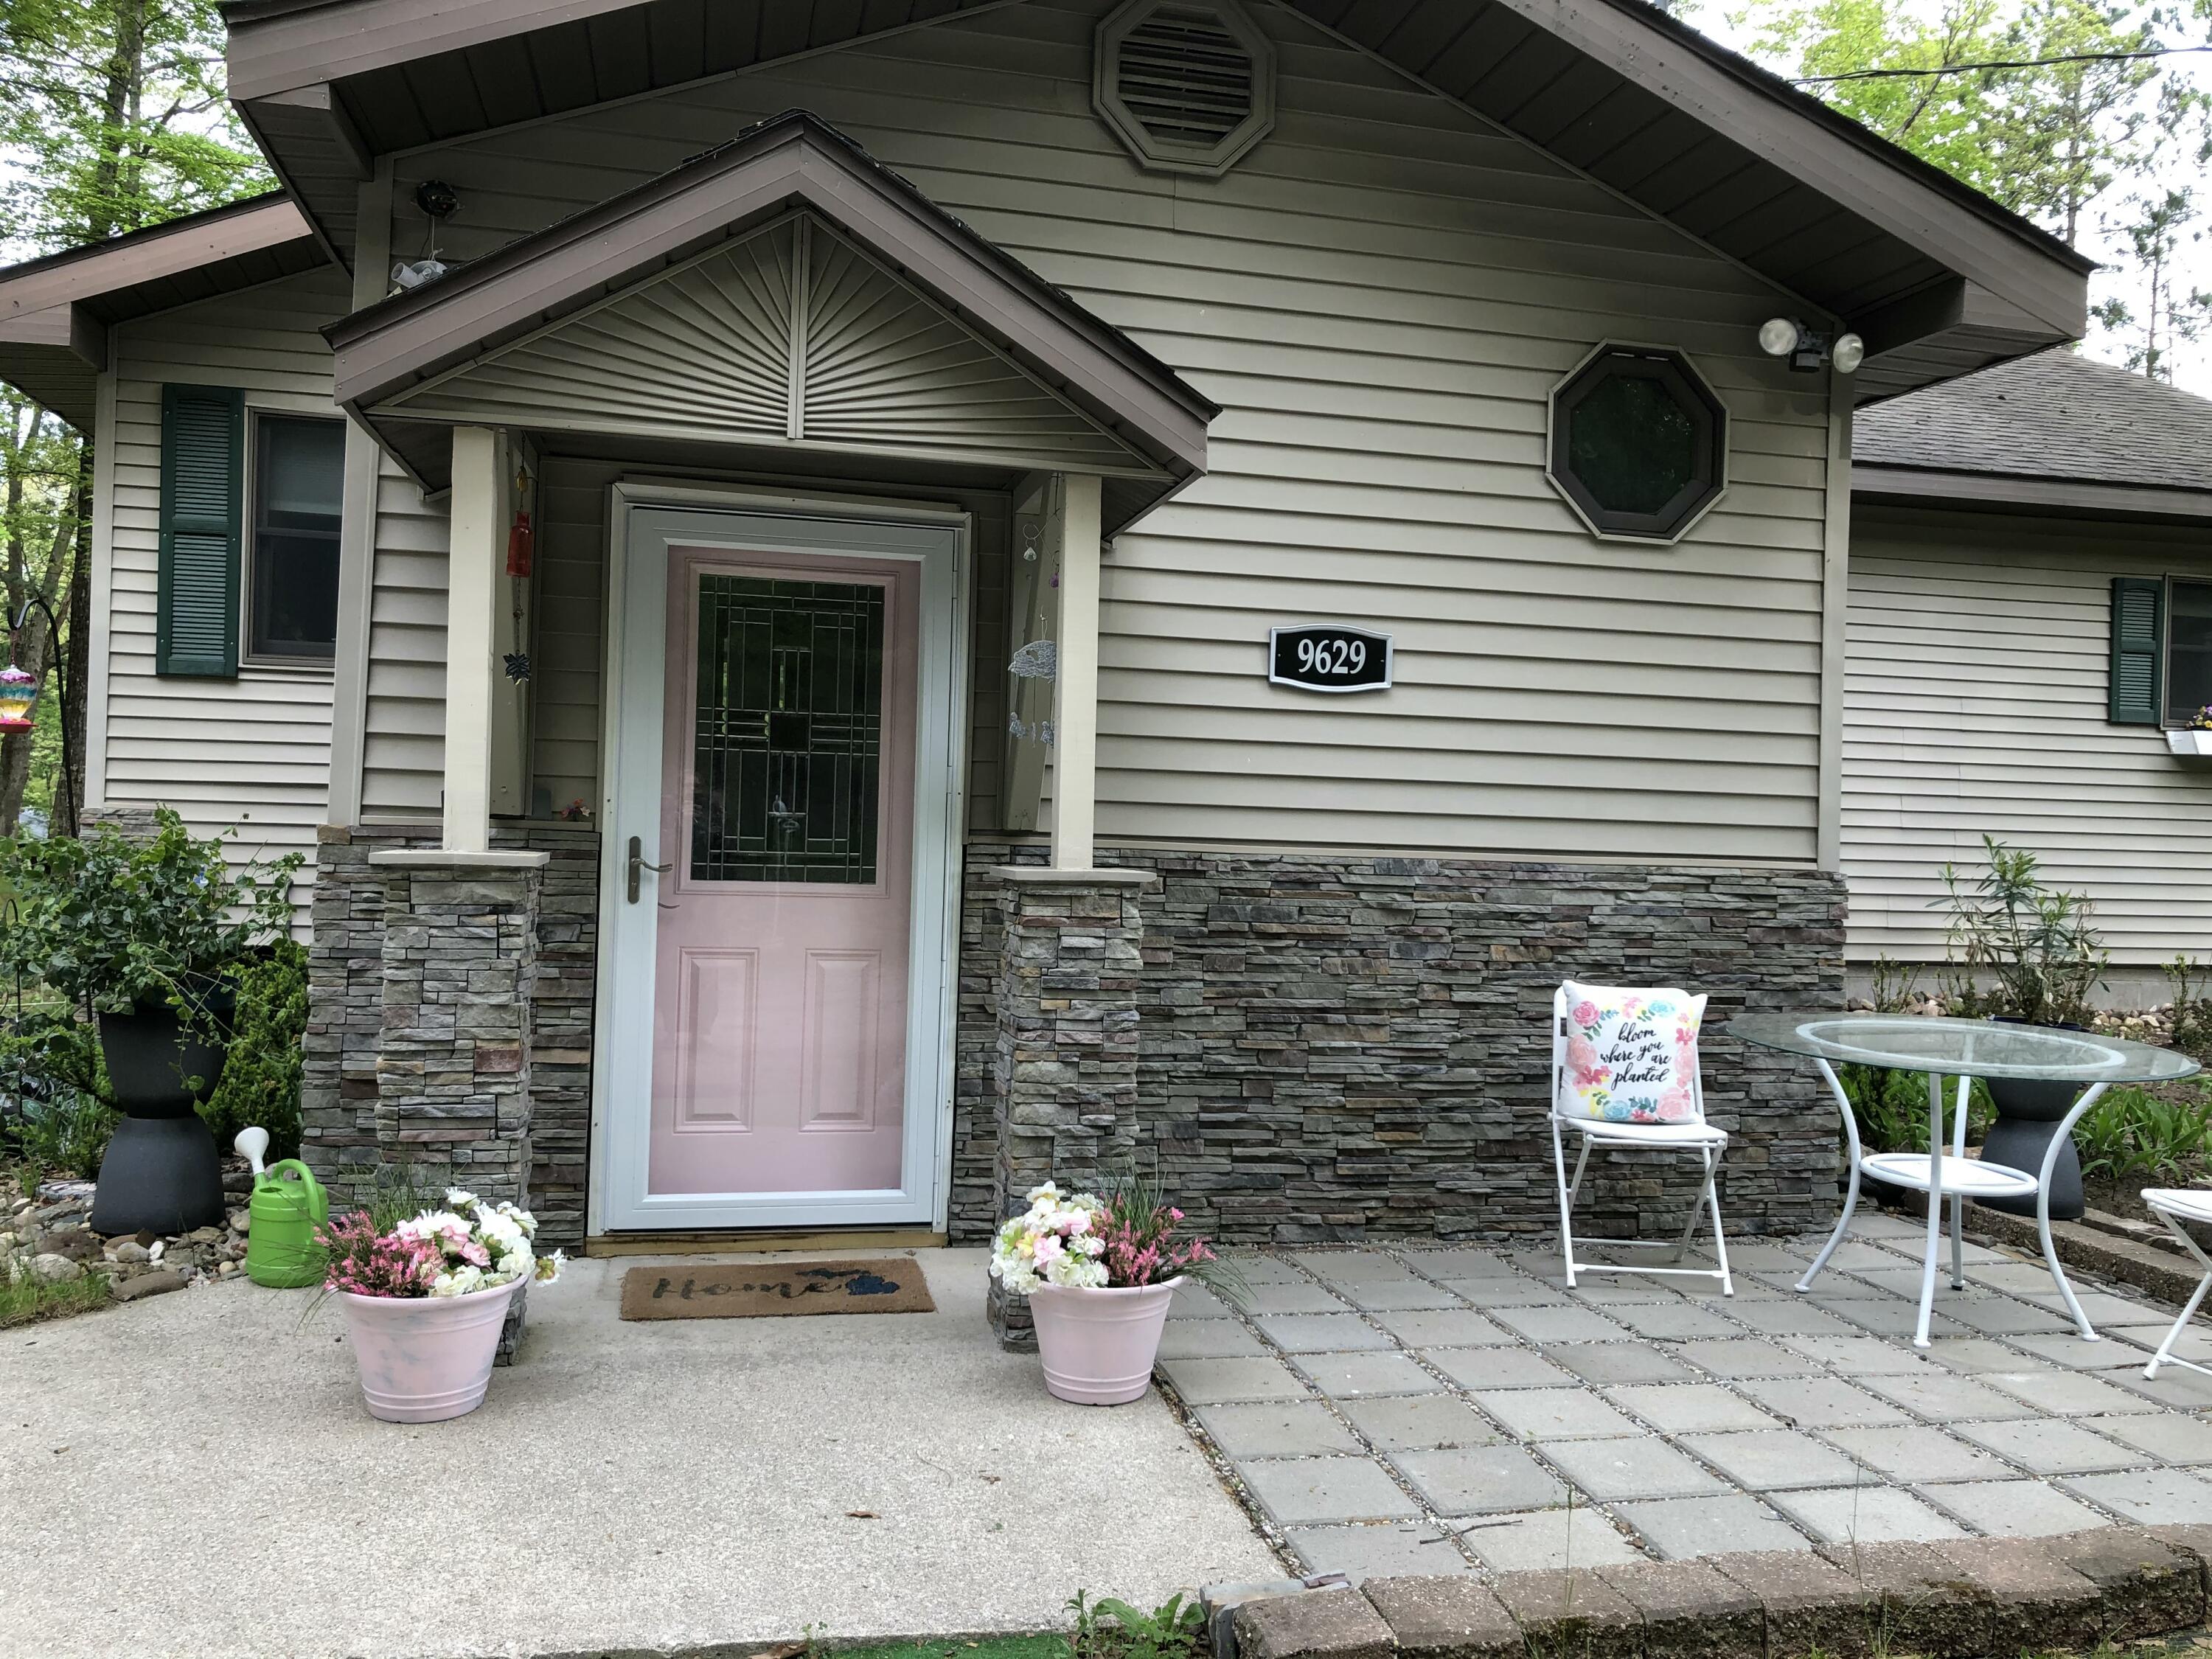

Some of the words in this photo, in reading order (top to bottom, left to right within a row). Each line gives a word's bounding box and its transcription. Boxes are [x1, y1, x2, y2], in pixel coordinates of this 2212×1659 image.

[1298, 639, 1366, 674] 9629
[1618, 1022, 1656, 1043] bloom
[1600, 1043, 1636, 1063] where
[1636, 1041, 1664, 1061] you
[1651, 1054, 1672, 1065] are
[1611, 1062, 1669, 1091] planted
[653, 1277, 842, 1299] Home
